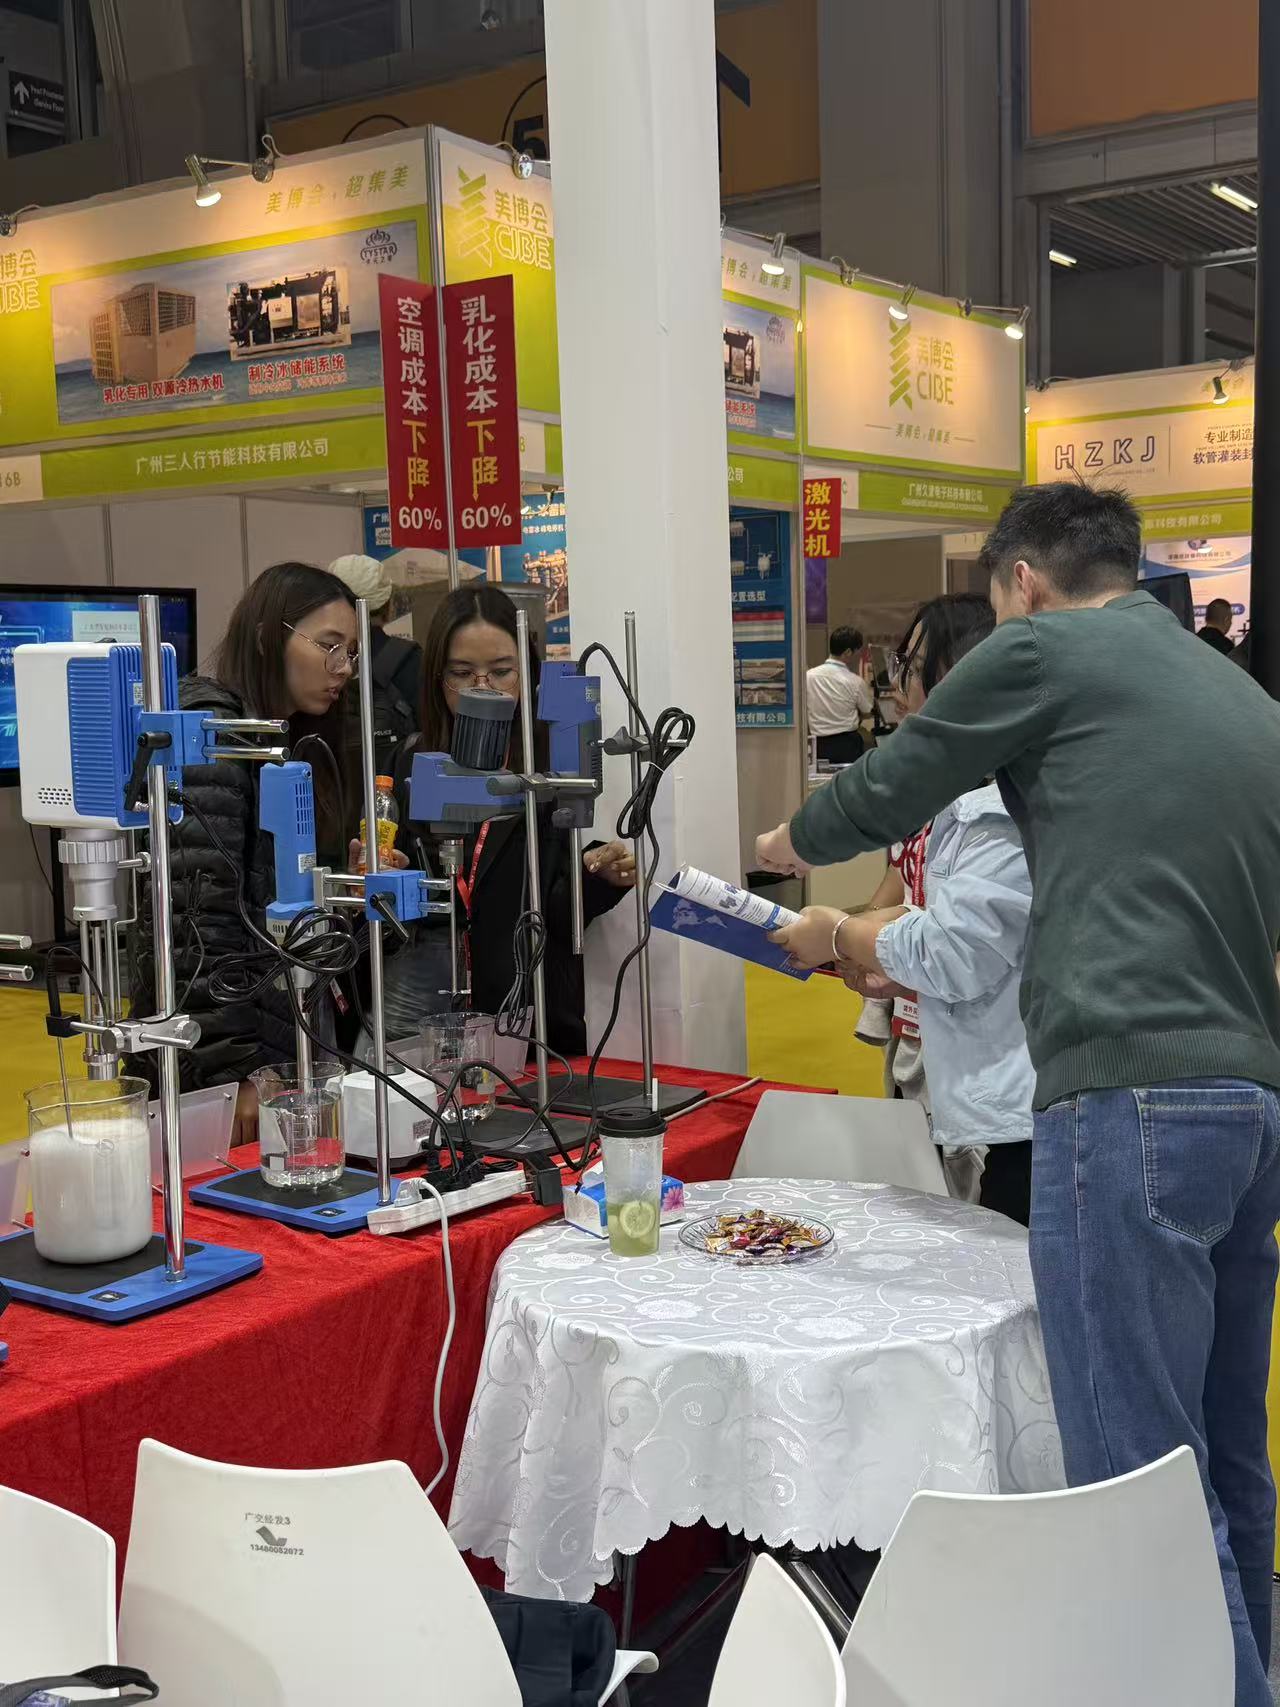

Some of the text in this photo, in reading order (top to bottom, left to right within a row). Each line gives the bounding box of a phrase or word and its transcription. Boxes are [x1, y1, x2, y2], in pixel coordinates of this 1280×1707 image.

[495, 190, 548, 234] 美博会
[363, 245, 394, 258] TYSTAR
[494, 224, 551, 271] CIBE
[103, 382, 149, 404] 乳化专用
[916, 371, 954, 405] CIBE
[1054, 435, 1156, 470] HZKJ
[1204, 428, 1253, 444] 专业制造
[135, 438, 330, 476] 广州三人行节能科技有限公司
[398, 506, 442, 531] 60%
[461, 503, 512, 530] 60%
[804, 481, 831, 557] 激光机
